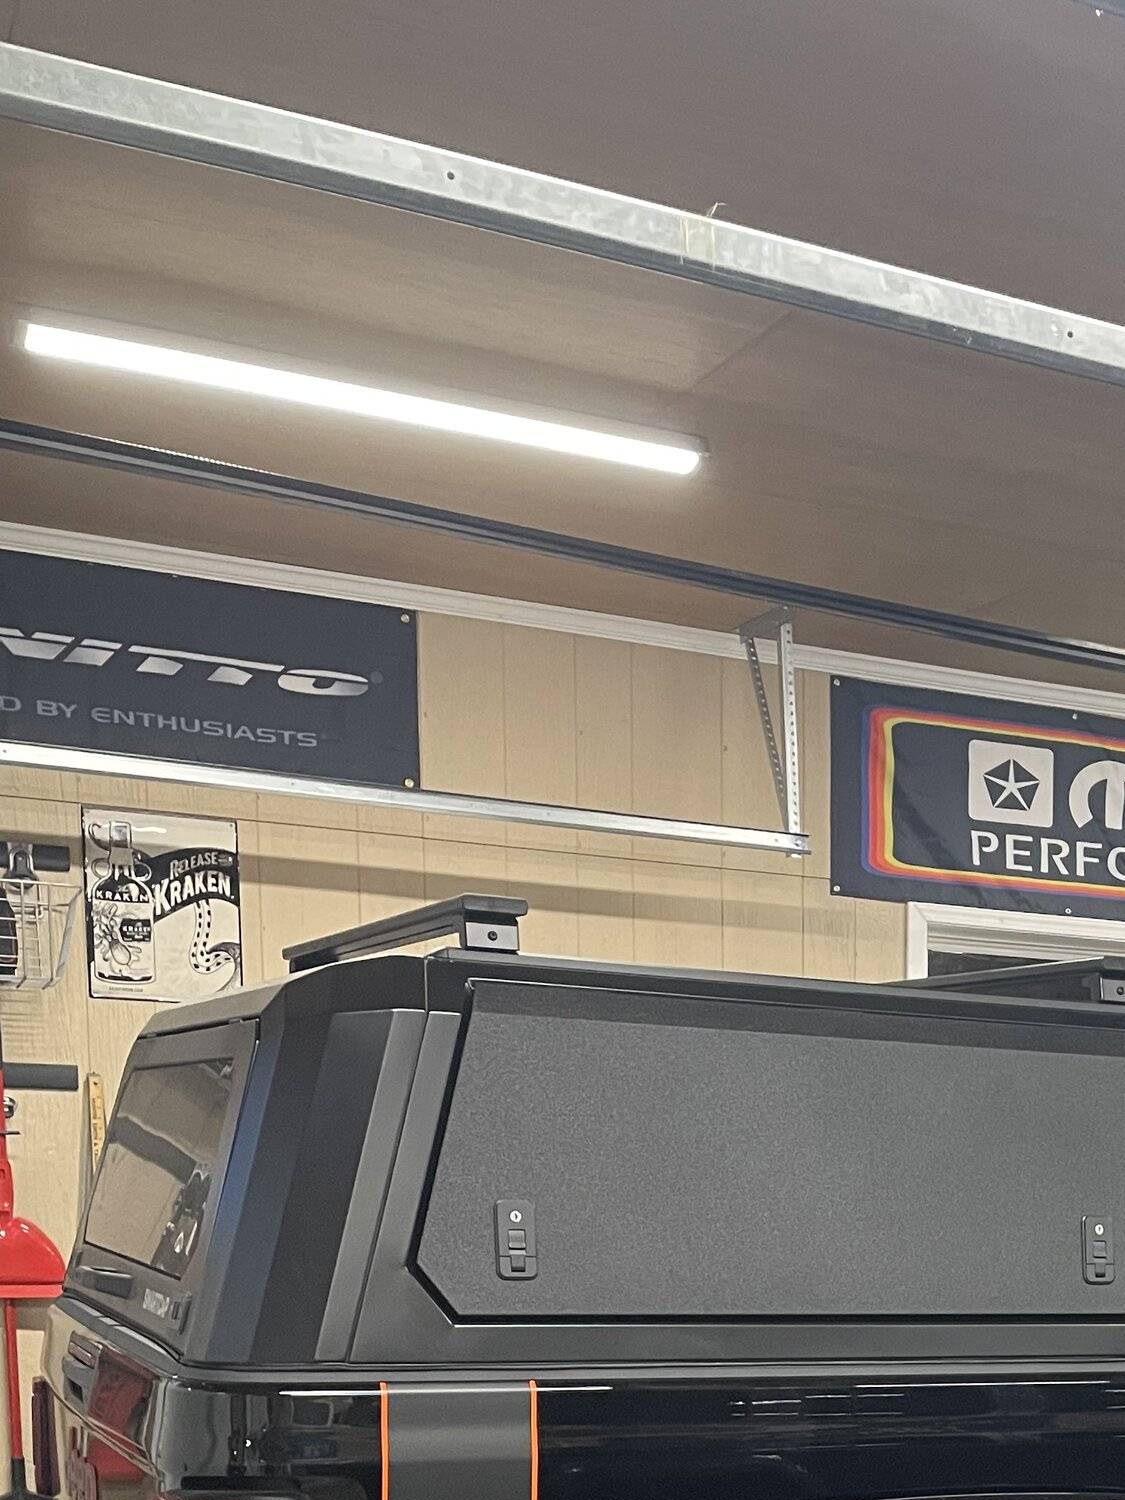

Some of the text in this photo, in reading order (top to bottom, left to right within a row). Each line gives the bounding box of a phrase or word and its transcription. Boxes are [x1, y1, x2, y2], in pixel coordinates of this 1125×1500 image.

[36, 699, 75, 719] BY
[90, 706, 318, 748] ENTHUSIASTS
[169, 852, 219, 881] RELEASE
